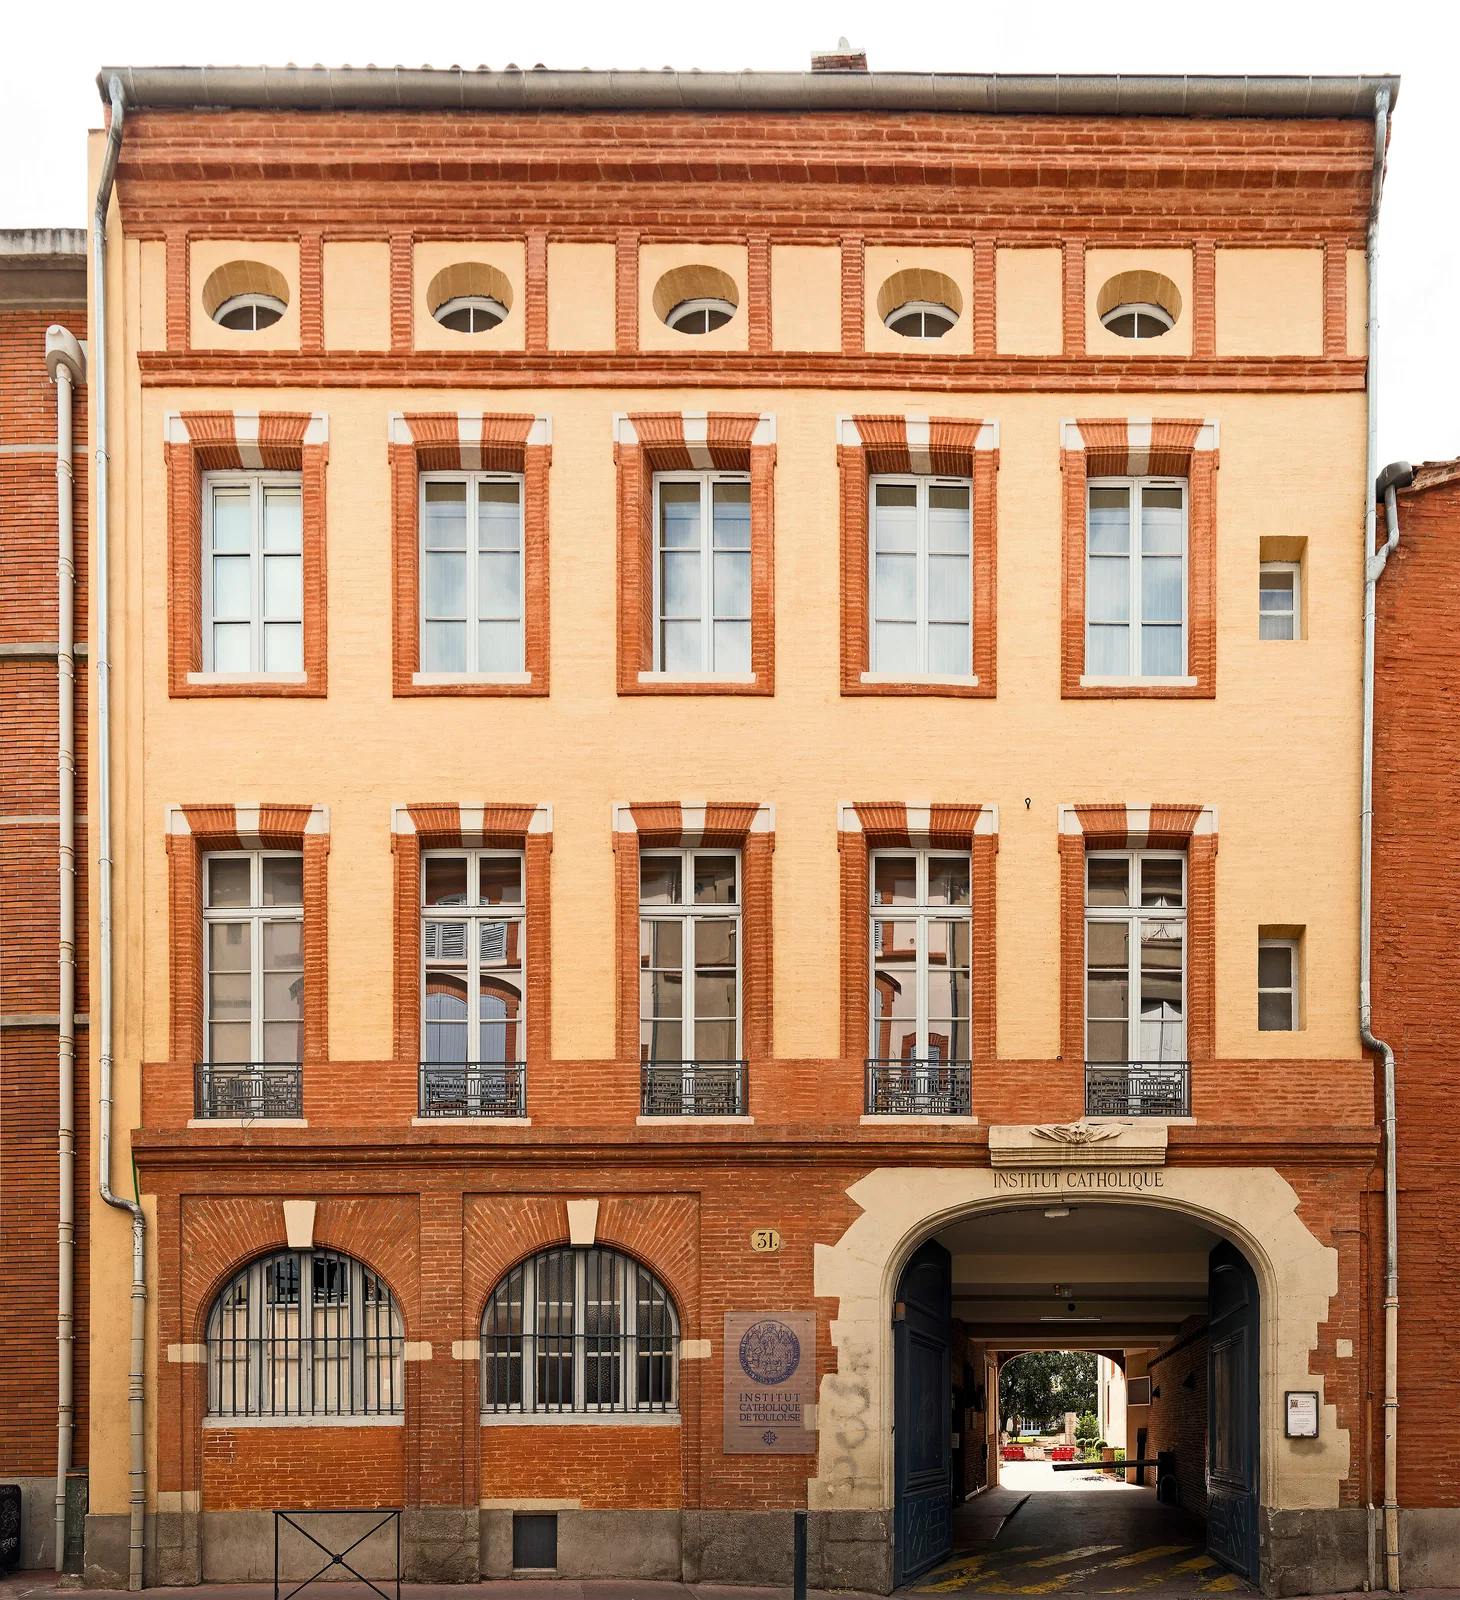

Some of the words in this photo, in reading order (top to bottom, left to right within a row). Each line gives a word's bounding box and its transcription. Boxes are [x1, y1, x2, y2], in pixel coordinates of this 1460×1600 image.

[993, 1172, 1061, 1188] INSTITUT
[1066, 1171, 1164, 1191] CATHOLIQUE
[739, 1393, 801, 1402] INSTITUT
[739, 1403, 801, 1413] CATHOLIQUE
[739, 1413, 752, 1421] DE
[752, 1413, 801, 1421] TOULOUSE
